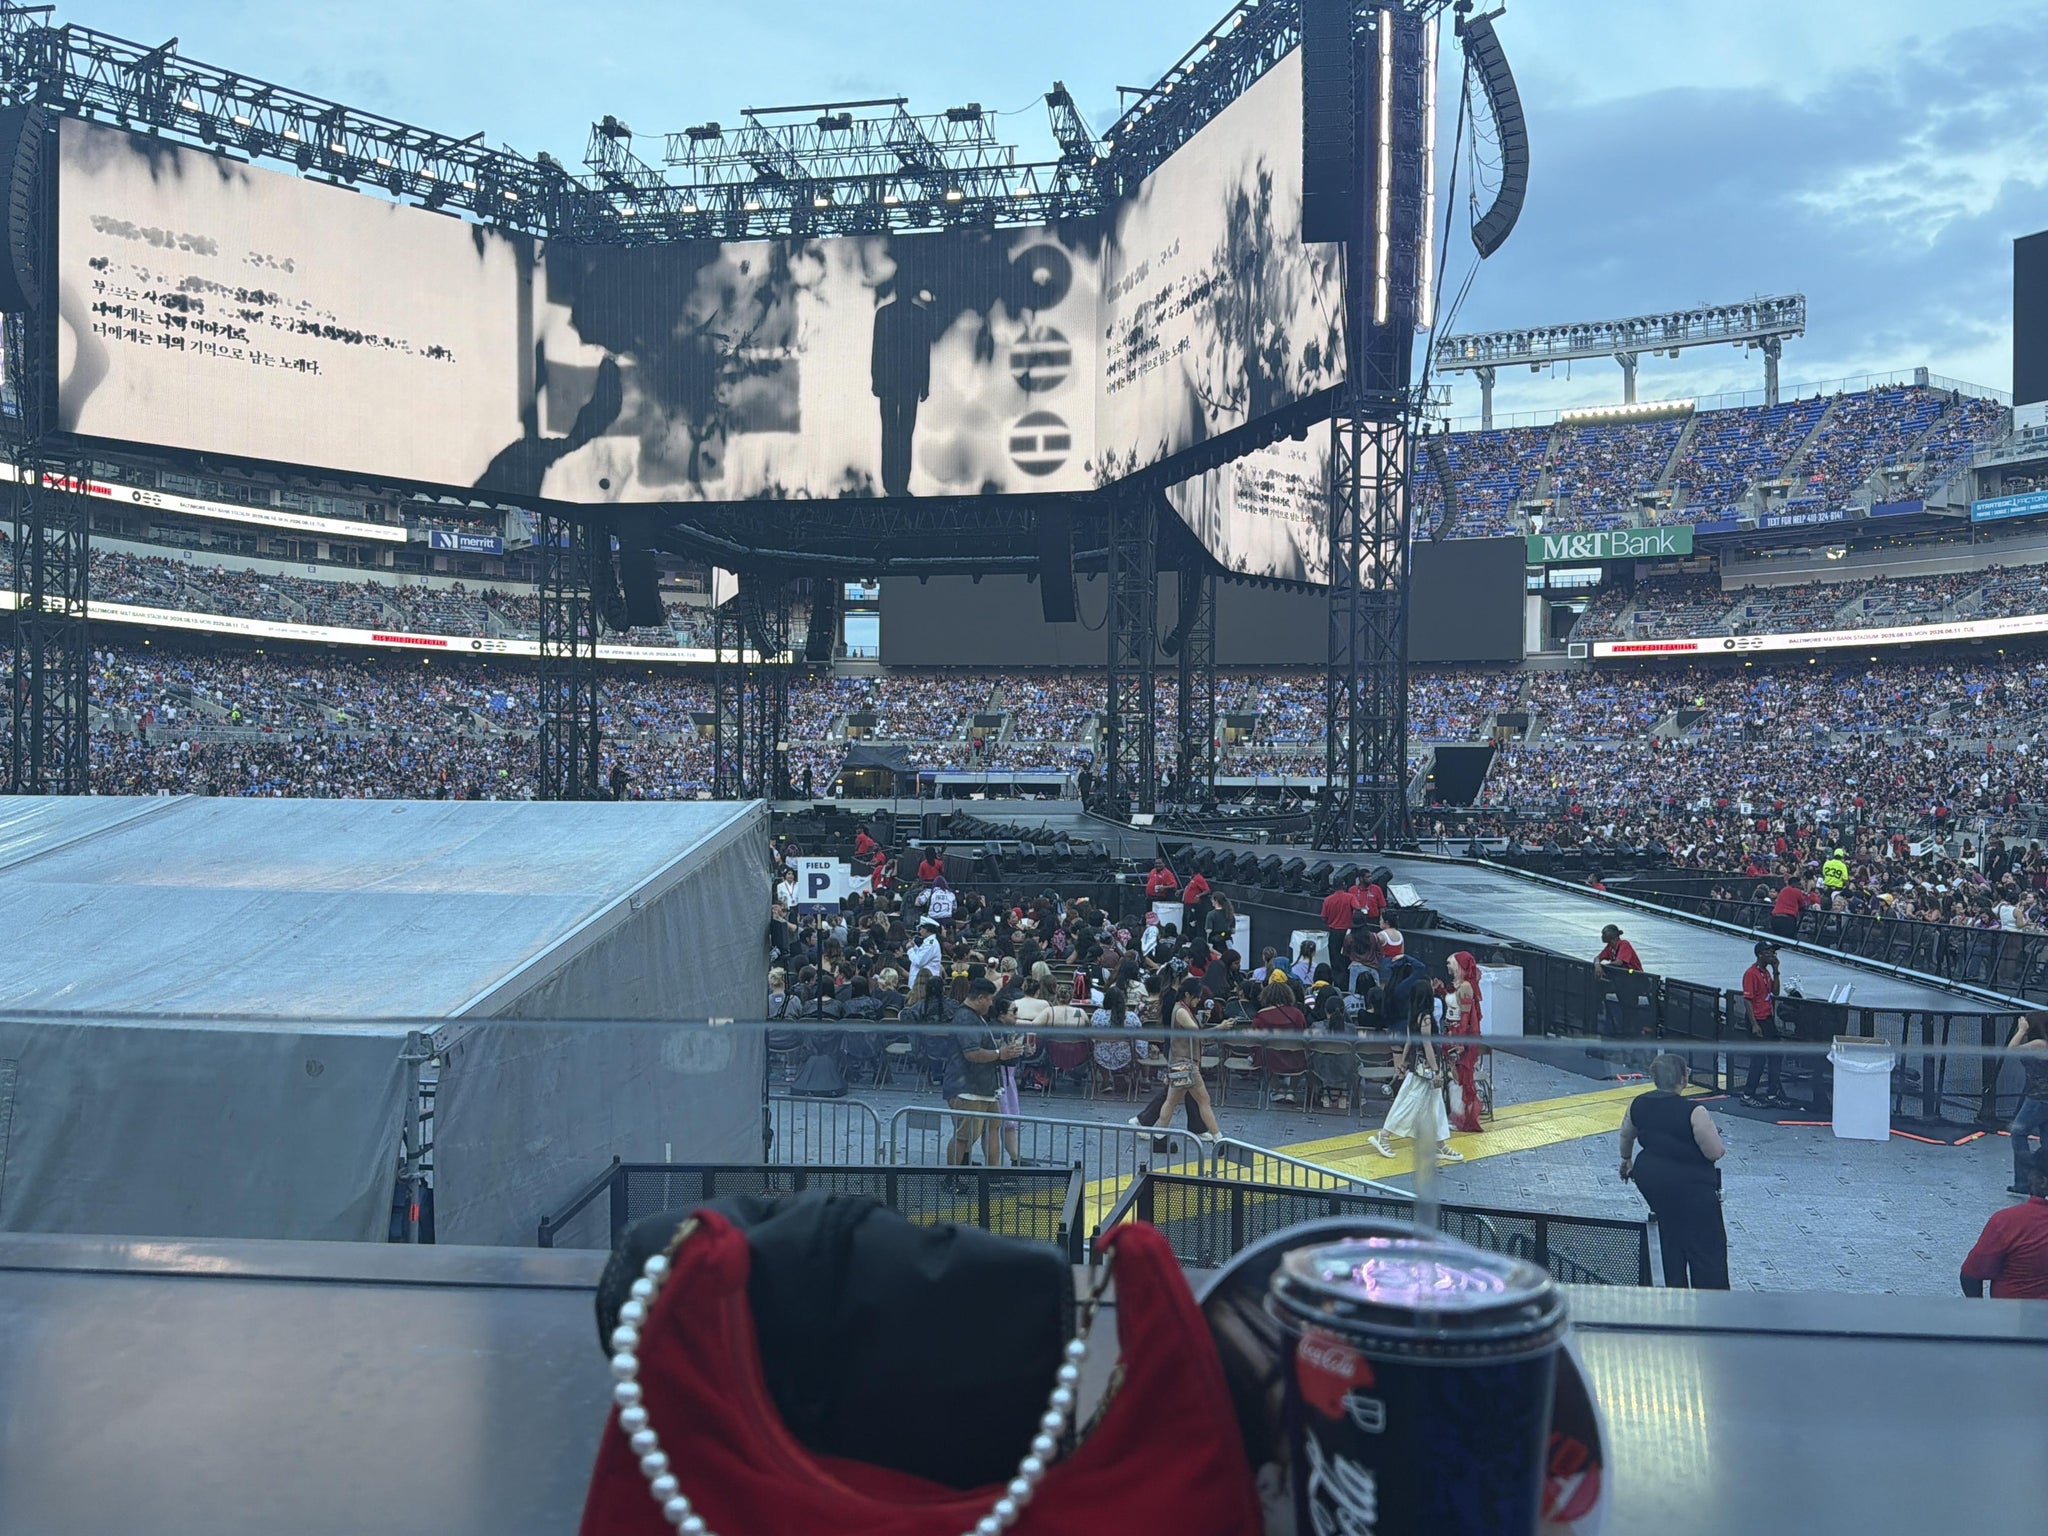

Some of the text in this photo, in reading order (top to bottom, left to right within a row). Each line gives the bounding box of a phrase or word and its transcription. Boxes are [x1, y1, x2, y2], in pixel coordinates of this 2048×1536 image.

[93, 322, 153, 345] 너에게는
[190, 340, 245, 360] 기억으로
[249, 350, 276, 367] 남는
[279, 357, 322, 375] 노래다.
[1767, 517, 1780, 526] TEXT
[1781, 516, 1792, 525] FOR
[1793, 515, 1806, 524] HELP
[460, 537, 495, 548] merritt
[1542, 528, 1676, 560] M&T Bank
[1824, 867, 1842, 879] 239
[808, 872, 831, 899] P
